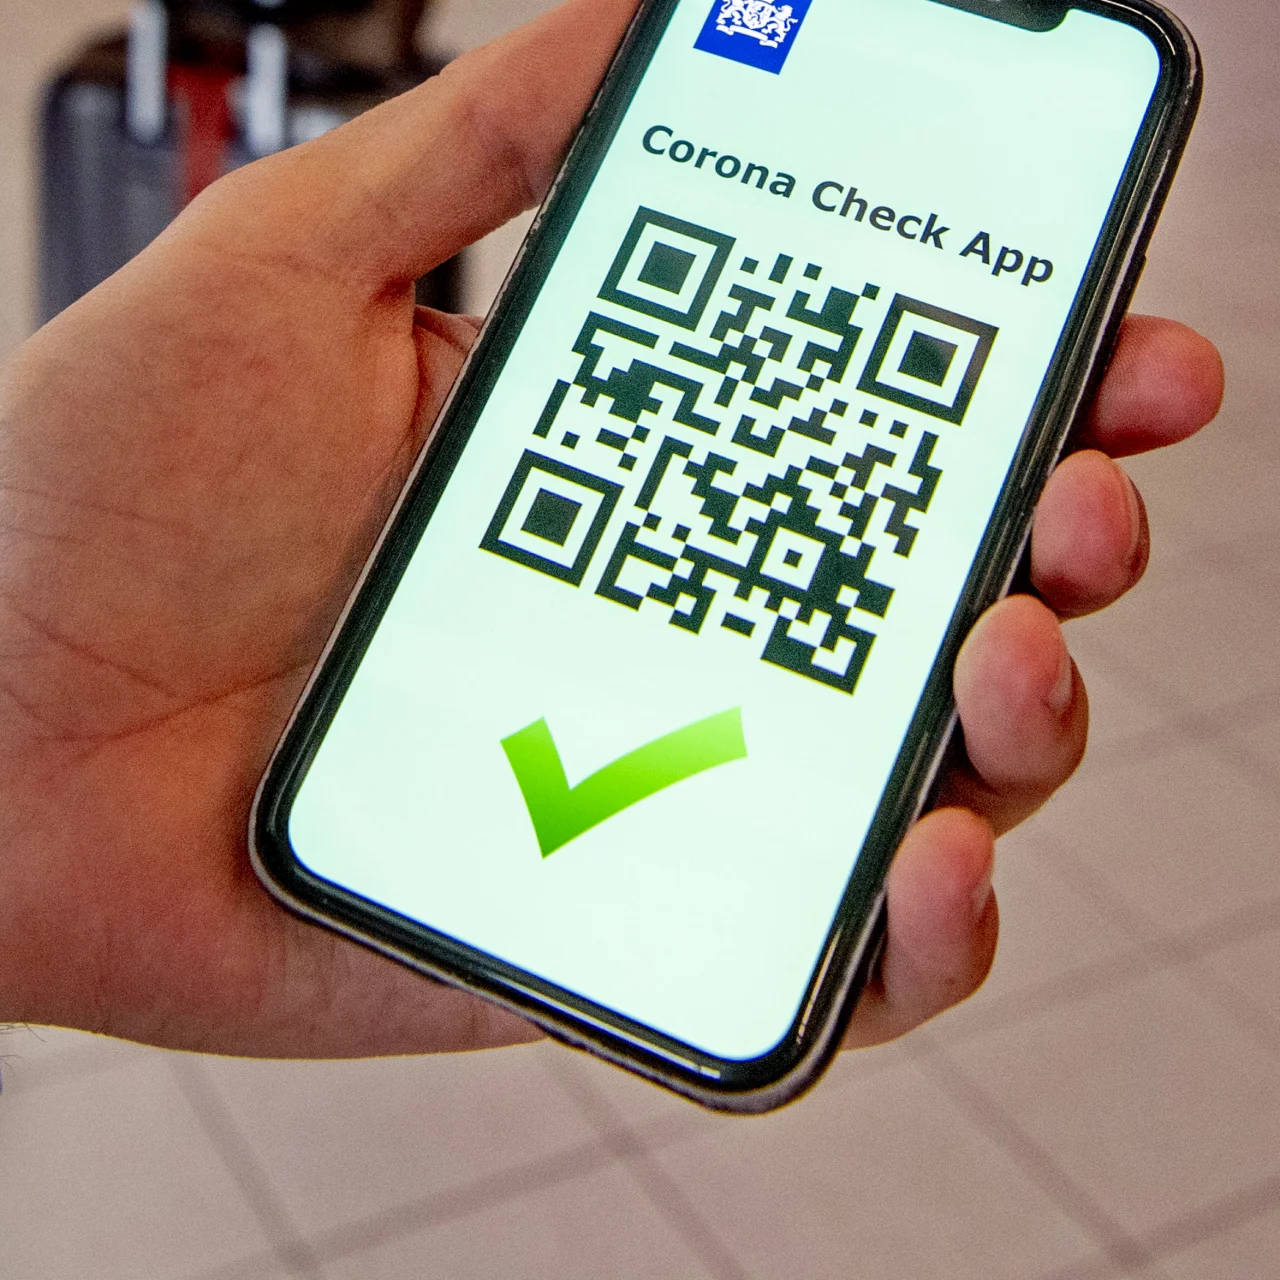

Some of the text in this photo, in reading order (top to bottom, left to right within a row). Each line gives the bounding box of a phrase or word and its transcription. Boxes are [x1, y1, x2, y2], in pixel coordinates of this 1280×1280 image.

[642, 125, 1055, 287] Corona Check App
